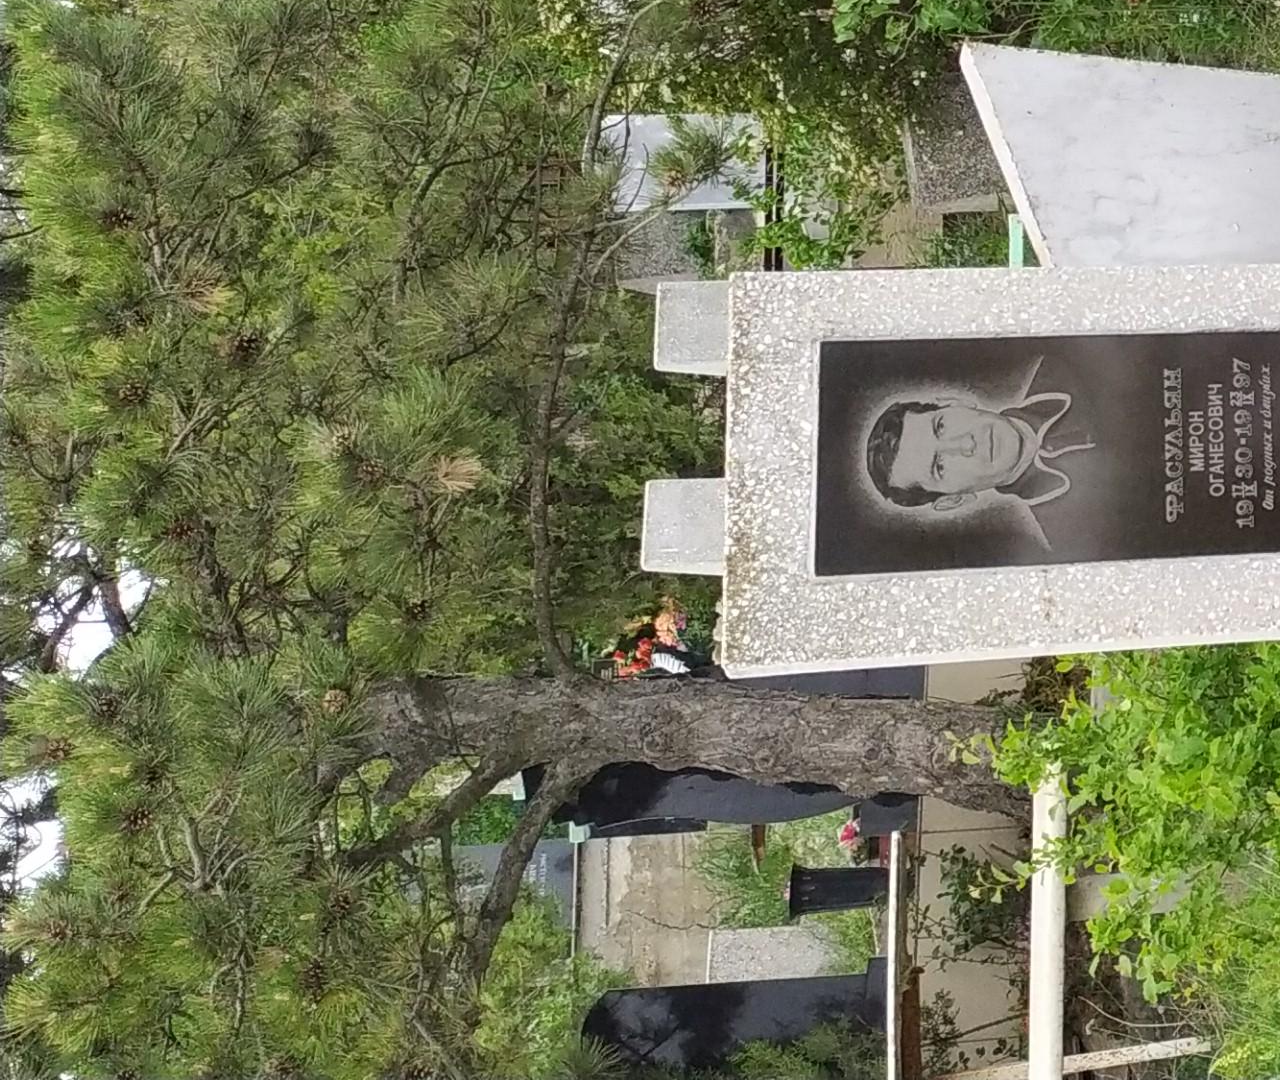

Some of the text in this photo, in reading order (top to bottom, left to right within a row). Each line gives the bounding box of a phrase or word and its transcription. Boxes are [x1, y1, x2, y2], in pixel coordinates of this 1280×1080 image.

[1164, 368, 1184, 522] ФАСУЛЬЯН
[1189, 411, 1205, 471] МИРОН
[1209, 384, 1225, 496] ОГАНЕСОВИЧ
[1264, 420, 1272, 429] и
[1261, 432, 1277, 486] родных
[1262, 489, 1274, 510] От
